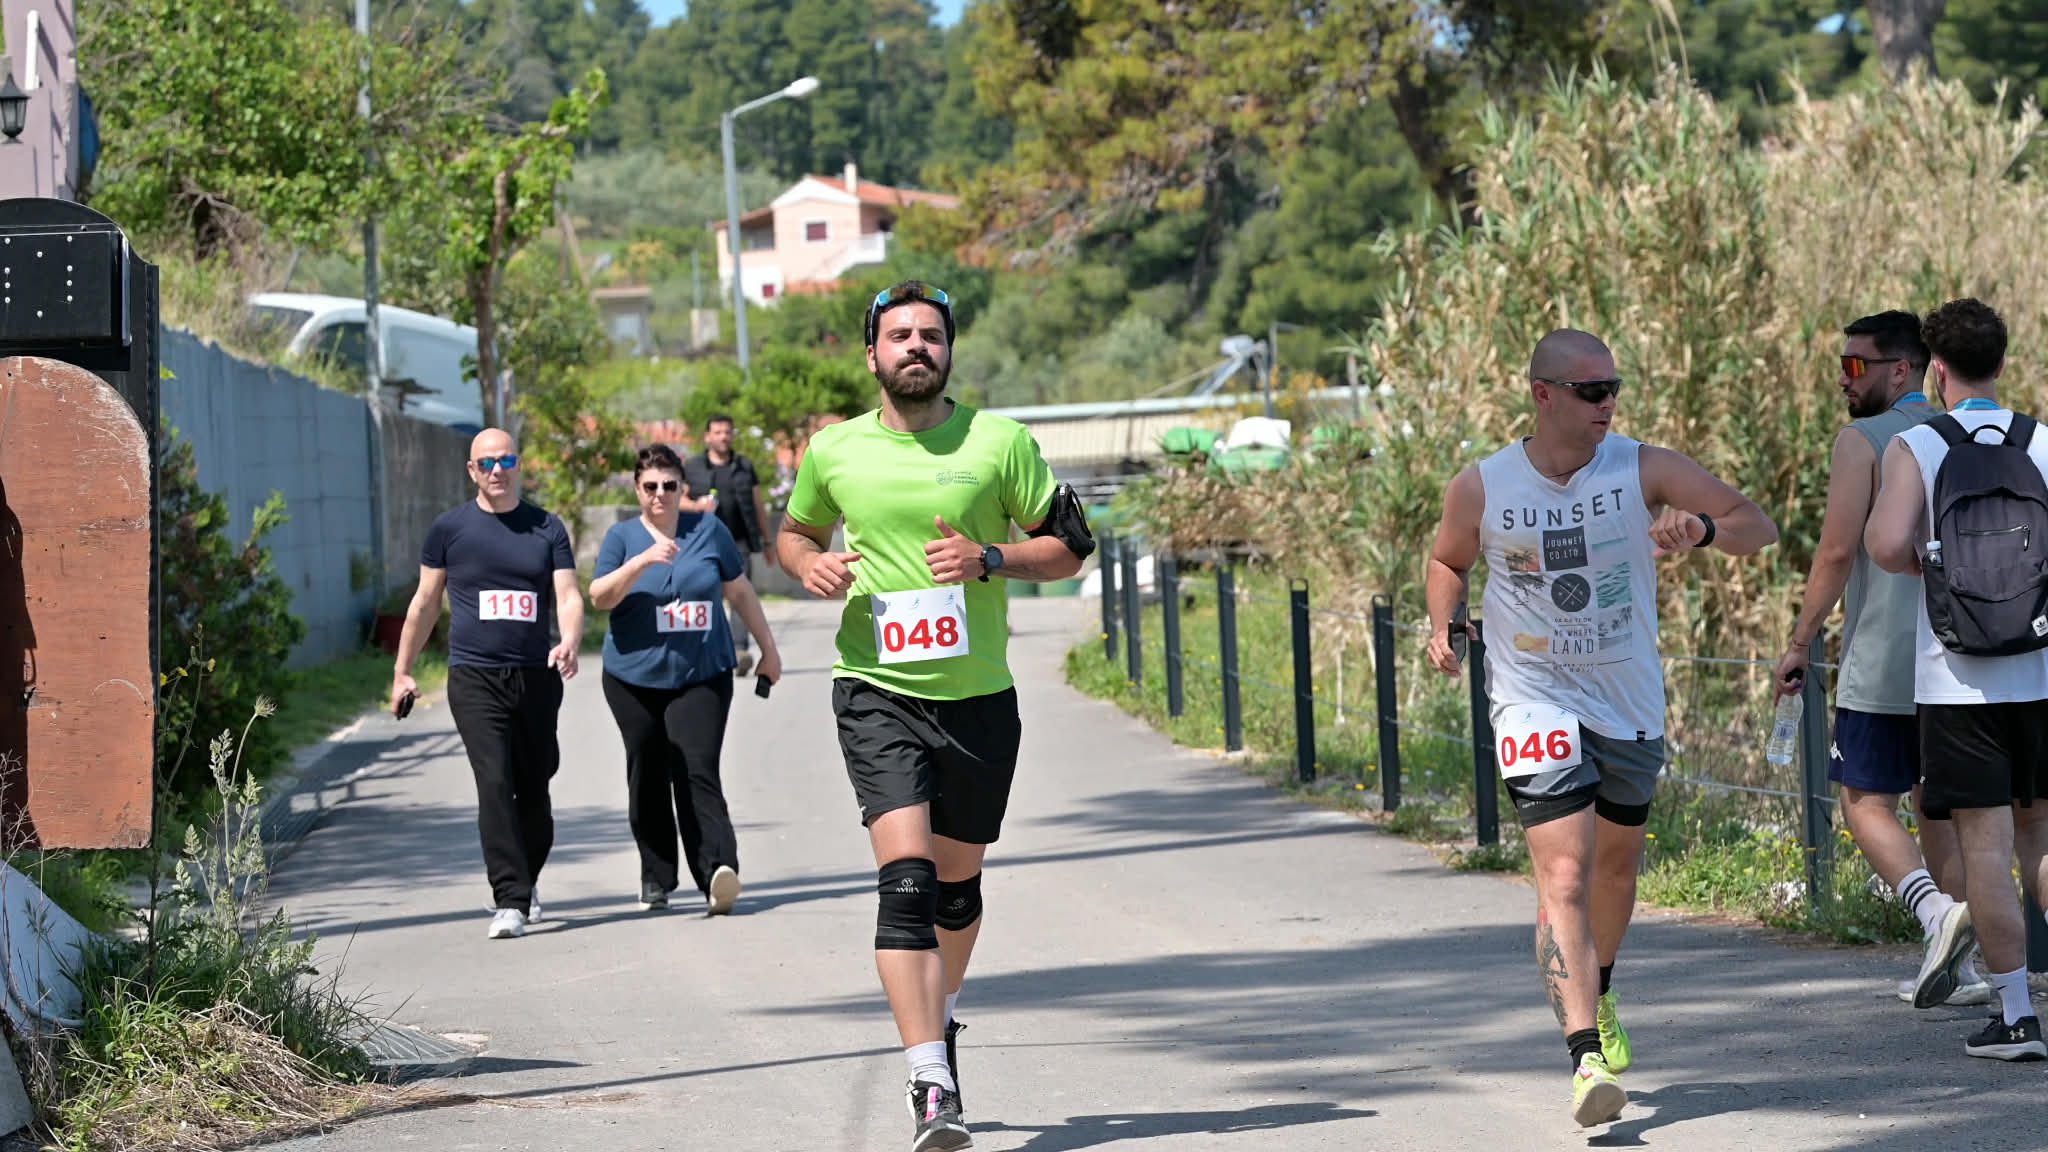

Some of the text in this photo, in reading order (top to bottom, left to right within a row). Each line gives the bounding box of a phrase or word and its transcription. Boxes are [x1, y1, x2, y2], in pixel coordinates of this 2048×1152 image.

[1503, 488, 1623, 530] SUNSET
[1546, 535, 1583, 549] JOURNEY
[488, 594, 533, 617] 119
[664, 604, 707, 628] 118
[883, 616, 959, 652] 048
[1552, 638, 1594, 655] LAND
[1501, 729, 1571, 767] 046
